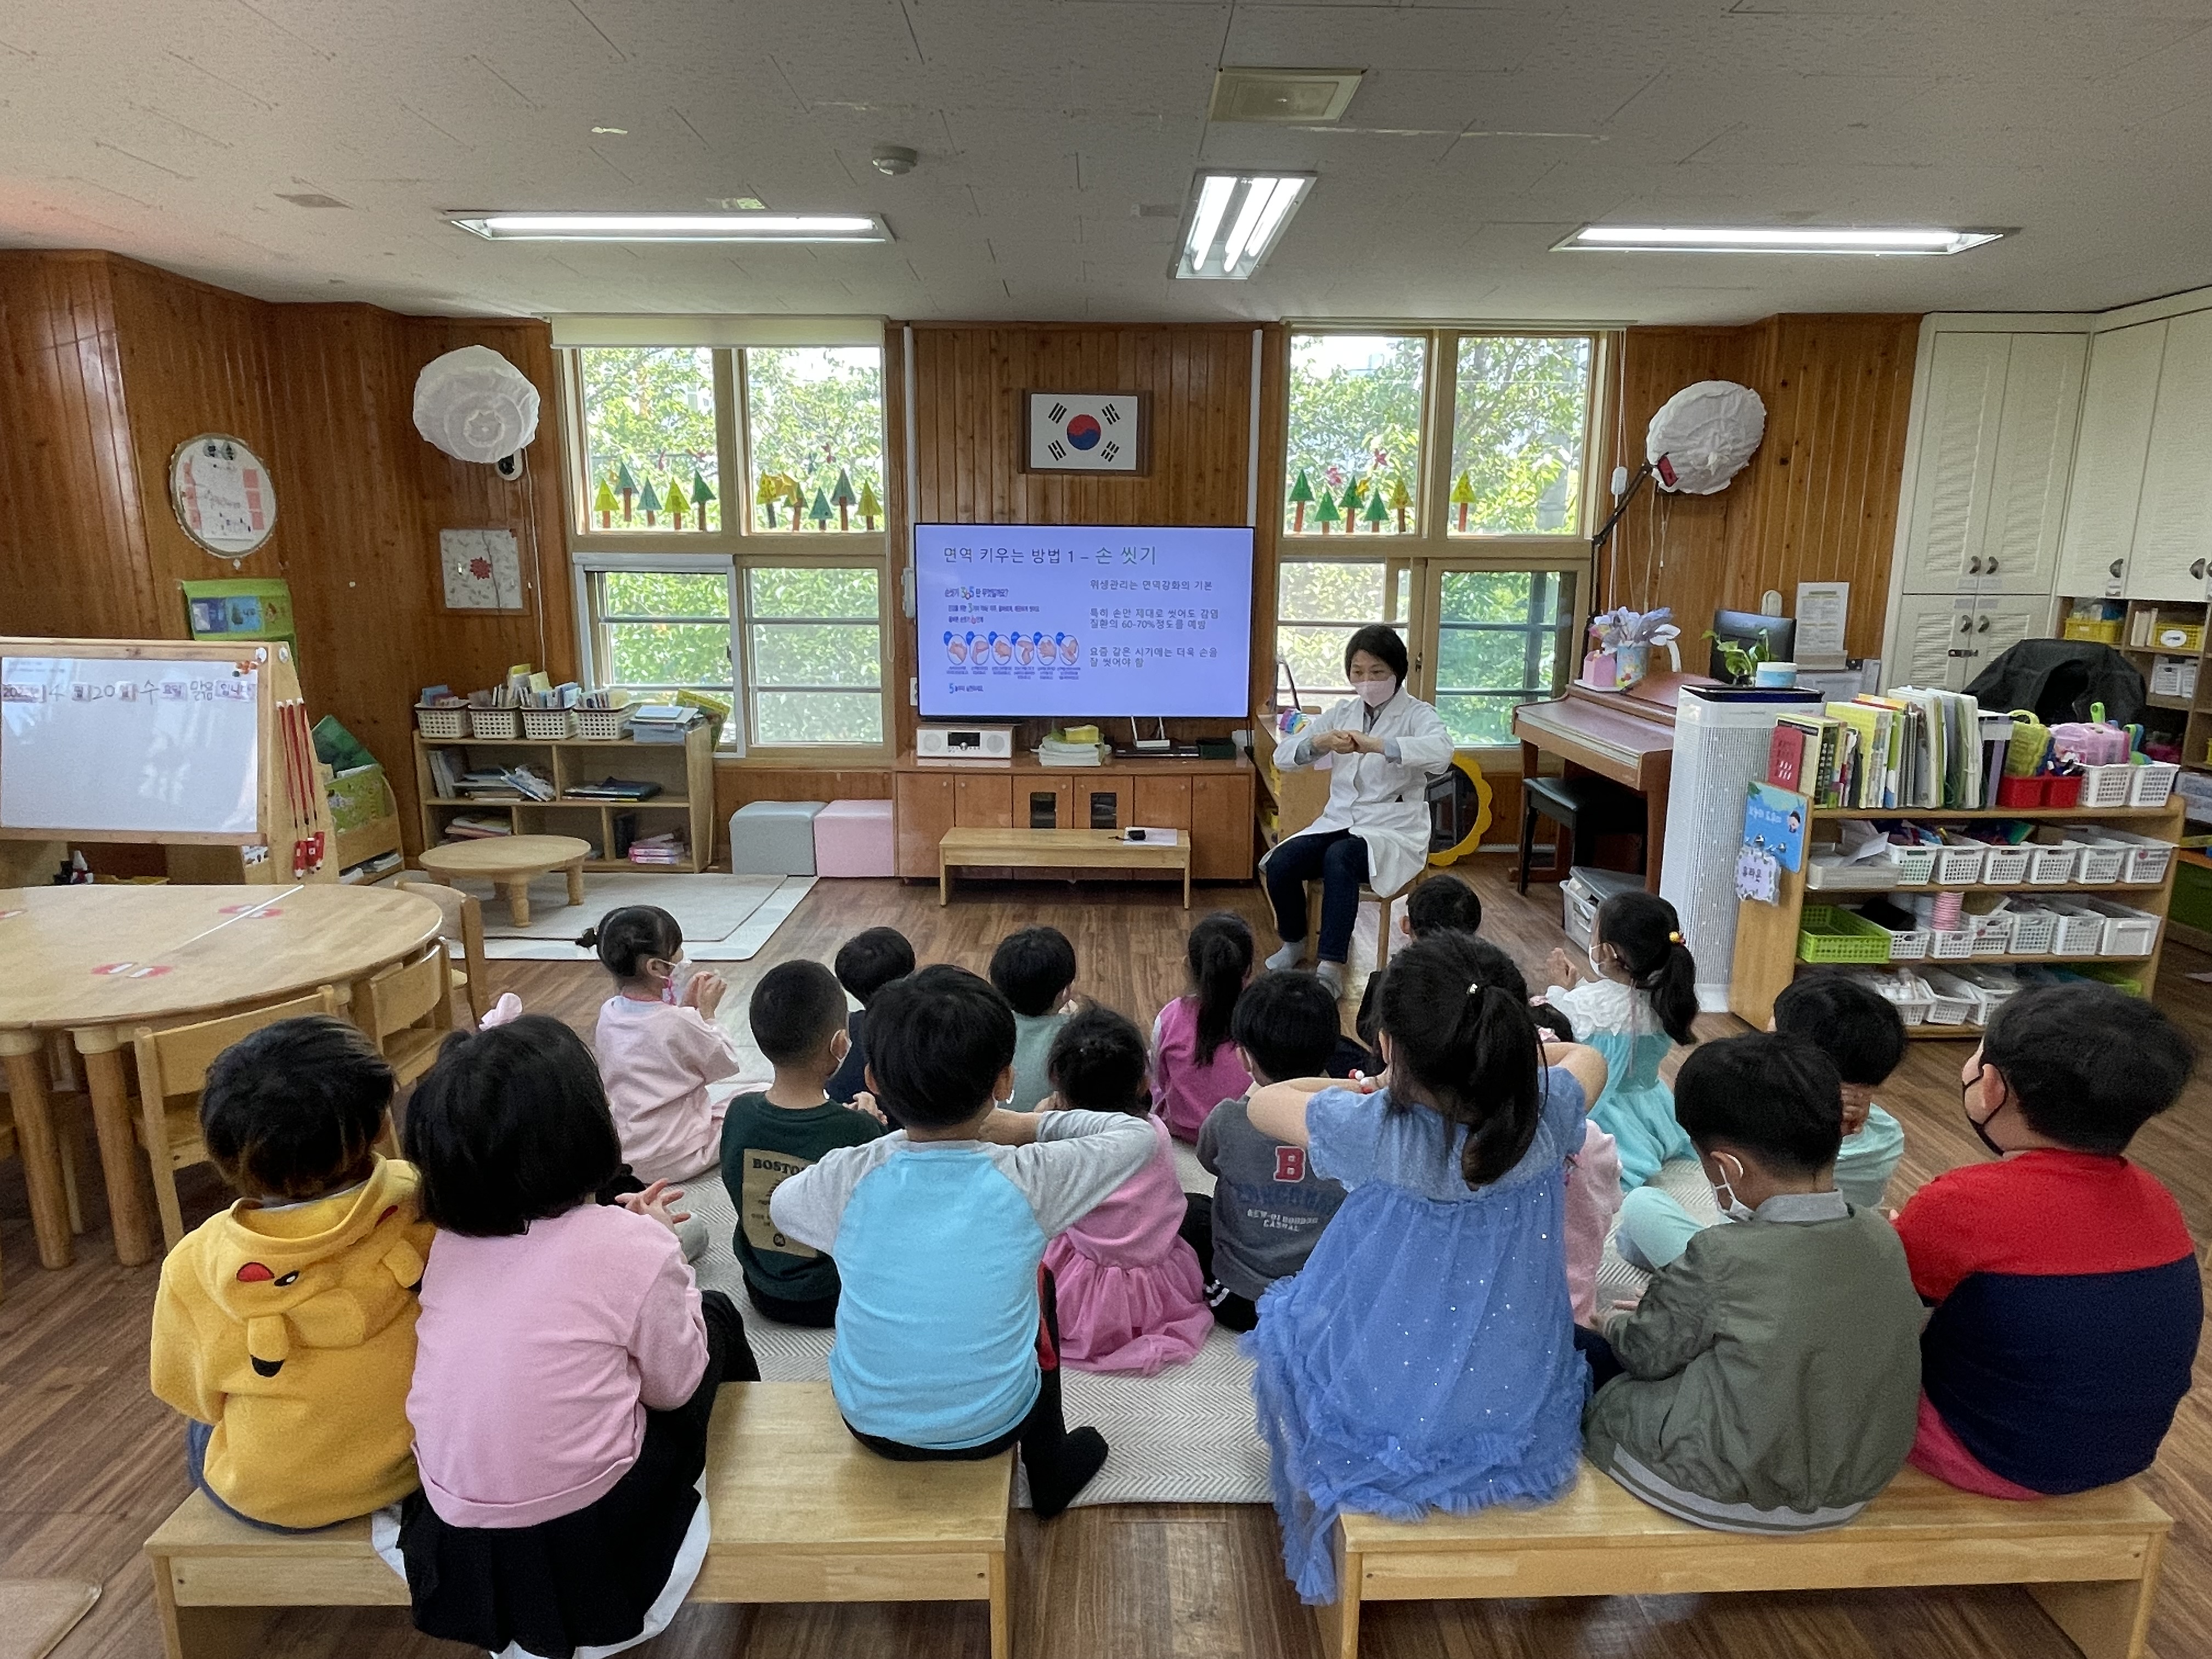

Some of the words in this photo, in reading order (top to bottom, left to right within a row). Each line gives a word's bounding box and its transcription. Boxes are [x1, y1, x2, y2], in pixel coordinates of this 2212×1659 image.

[944, 546, 973, 563] 면역
[979, 547, 1025, 563] 키우는
[1031, 548, 1060, 564] 방법
[1068, 550, 1074, 563] 1
[1095, 546, 1113, 565] 손
[1120, 545, 1156, 565] 씻기
[1090, 579, 1138, 590] 위생관리는
[1142, 580, 1190, 591] 면역강화의
[1194, 580, 1212, 591] 기본
[1090, 608, 1108, 618] 특히
[1113, 608, 1131, 618] 손만
[1136, 608, 1164, 619] 제대로
[1167, 609, 1195, 619] 씻어도
[1200, 609, 1218, 619] 감염
[1090, 619, 1118, 629] 질환의
[1187, 619, 1206, 630] 예방
[1090, 647, 1108, 657] 요즘
[1135, 647, 1173, 657] 시기에는
[1176, 647, 1194, 658] 더욱
[1199, 647, 1218, 658] 손을
[1103, 658, 1131, 668] 씻어야
[190, 680, 214, 701] 맑음
[753, 1158, 805, 1176] BOSTO
[1273, 1146, 1306, 1183] B
